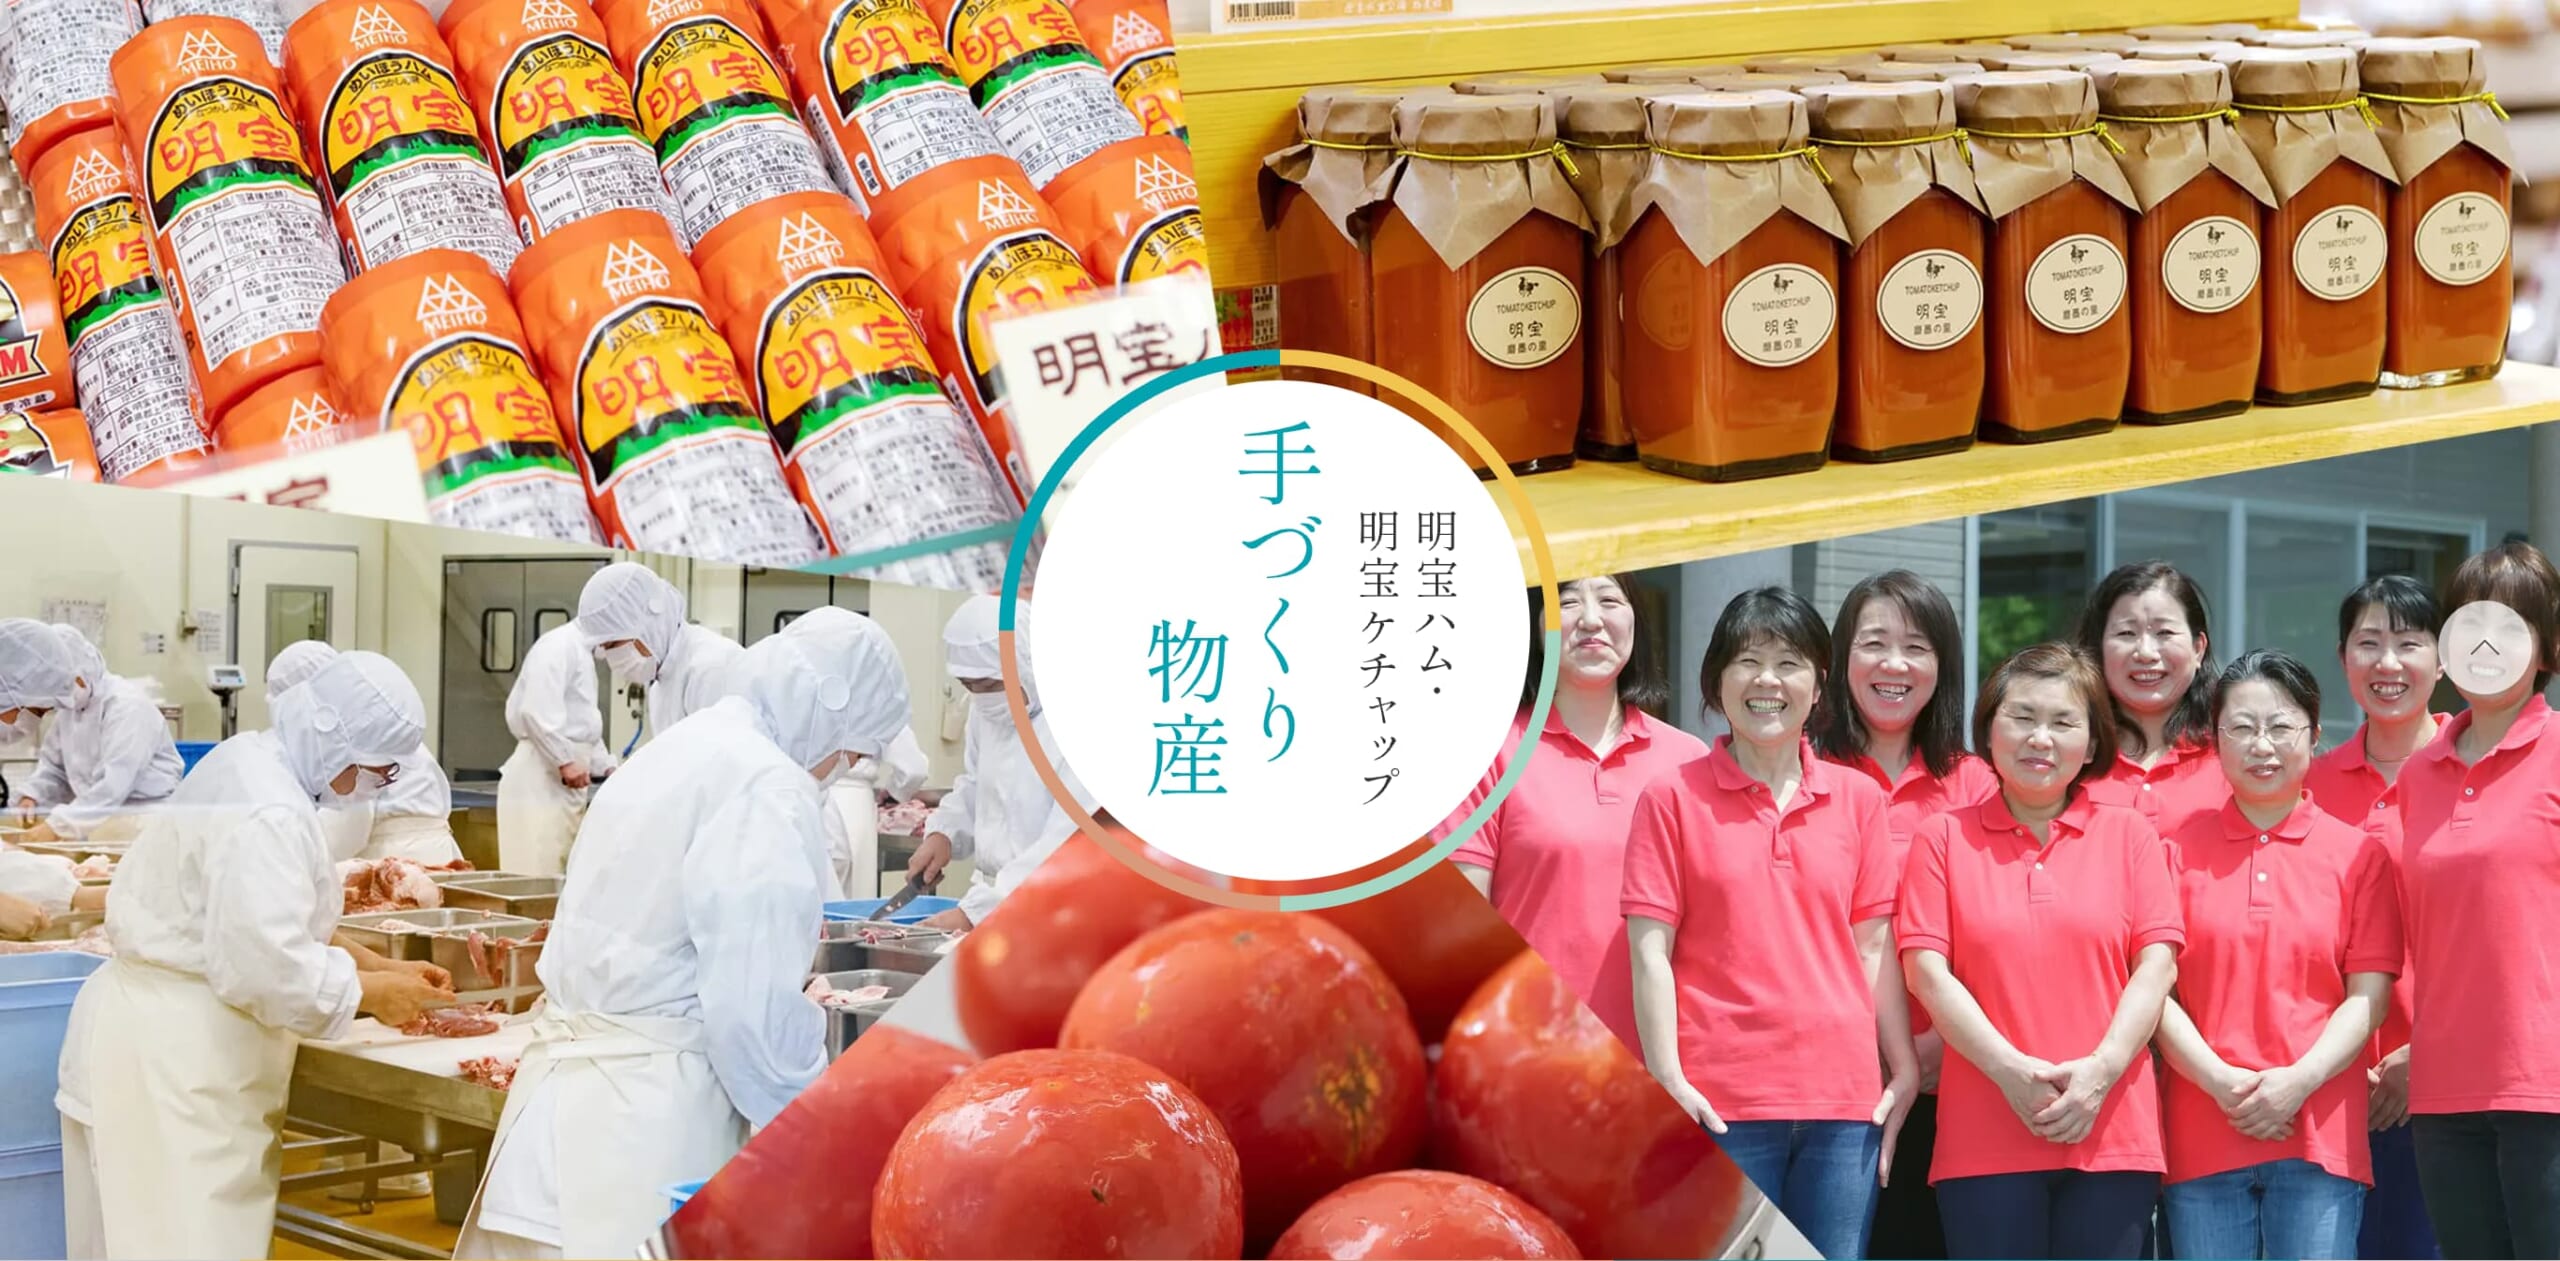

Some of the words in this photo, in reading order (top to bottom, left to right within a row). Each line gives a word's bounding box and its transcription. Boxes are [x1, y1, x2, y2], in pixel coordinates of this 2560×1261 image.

[650, 0, 704, 26] MEIHO
[526, 17, 578, 33] MEIHO
[354, 32, 408, 50] MEIHO
[651, 27, 732, 69] めいほうハム
[181, 60, 238, 76] MEIHO
[348, 59, 433, 94] めいほうハム
[646, 52, 769, 123] 明宝
[173, 84, 261, 119] めいほうハム
[509, 71, 636, 130] 明宝
[338, 88, 471, 149] 明宝
[159, 114, 303, 177] 明宝
[70, 177, 121, 204] MEIHO
[1143, 187, 1199, 208] MEIHO
[984, 212, 1041, 233] MEIHO
[784, 245, 845, 273] MEIHO
[2052, 265, 2104, 281] TOMATOKETCHUP
[2200, 267, 2229, 284] 明宝
[610, 275, 671, 300] MEIHO
[1905, 282, 1960, 296] TOMATOKETCHUP
[2064, 286, 2094, 304] 明宝
[786, 280, 880, 327] めいほうハム
[1497, 300, 1556, 314] TOMATOKETCHUP
[1752, 296, 1811, 312] TOMATOKETCHUP
[1916, 303, 1948, 319] 明宝
[423, 311, 488, 333] MEIHO
[1509, 320, 1543, 339] 明宝
[1765, 318, 1798, 336] 明宝
[774, 315, 926, 394] 明宝
[592, 346, 744, 422] 明宝
